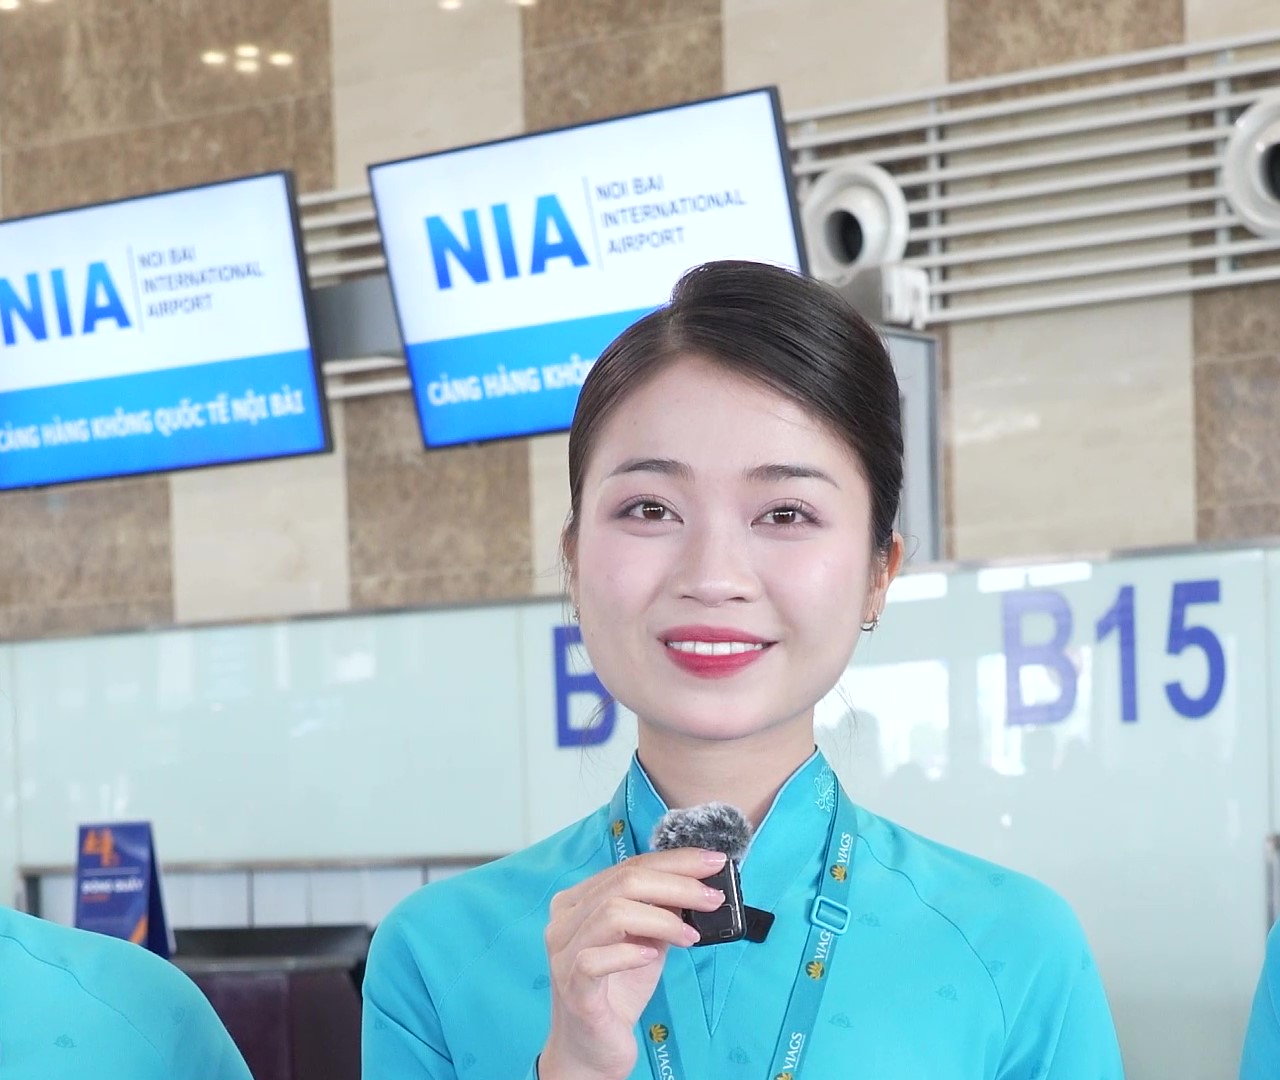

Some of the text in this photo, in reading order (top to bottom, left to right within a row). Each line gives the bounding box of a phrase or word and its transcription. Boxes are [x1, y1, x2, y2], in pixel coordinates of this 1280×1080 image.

[601, 190, 747, 228] INTERNATIONAL
[424, 194, 590, 291] NIA
[607, 226, 686, 255] AIRPORT
[144, 262, 264, 293] INTERNATIONAL
[148, 294, 213, 318] AIRPORT
[484, 364, 539, 399] HÀNG
[1000, 578, 1226, 728] B15
[837, 832, 852, 865] VIAGS
[814, 929, 831, 960] VIAG
[783, 1031, 803, 1071] VIAGS
